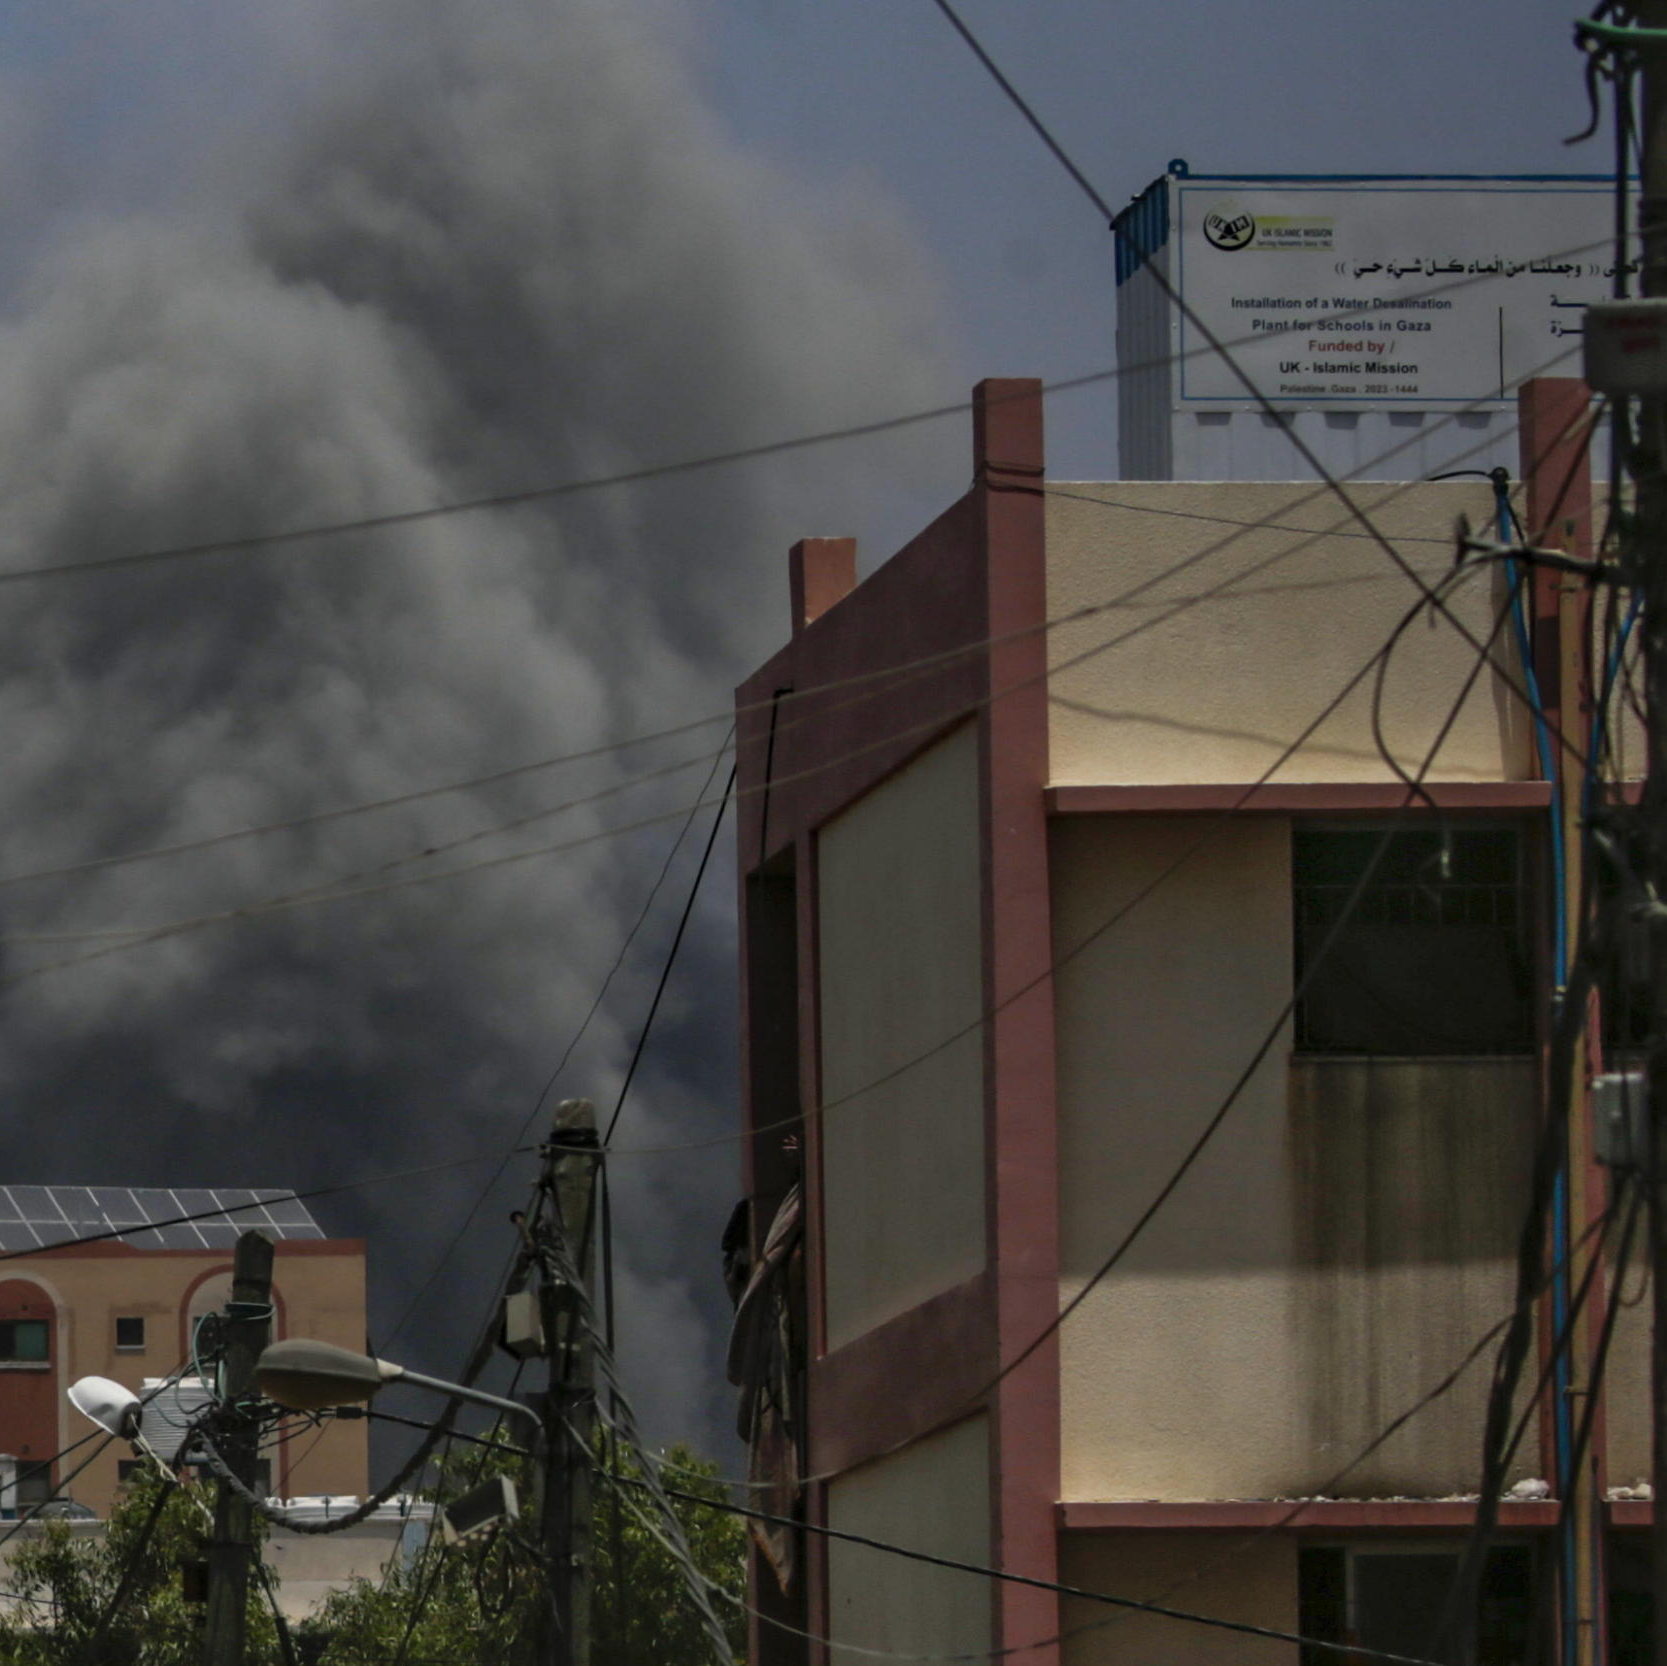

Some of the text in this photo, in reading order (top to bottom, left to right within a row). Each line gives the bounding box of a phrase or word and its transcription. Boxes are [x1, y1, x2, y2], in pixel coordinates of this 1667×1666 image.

[1274, 227, 1301, 238] ISLAMIC
[1303, 227, 1333, 238] MISSION
[1231, 297, 1452, 310] Installation of a Water Desalination
[1252, 319, 1432, 332] Plant for Schools in Gaza
[1308, 339, 1363, 353] Funded
[1367, 339, 1385, 355] by
[1279, 361, 1300, 374] UK
[1313, 361, 1361, 374] Islamic
[1365, 361, 1418, 374] Mission
